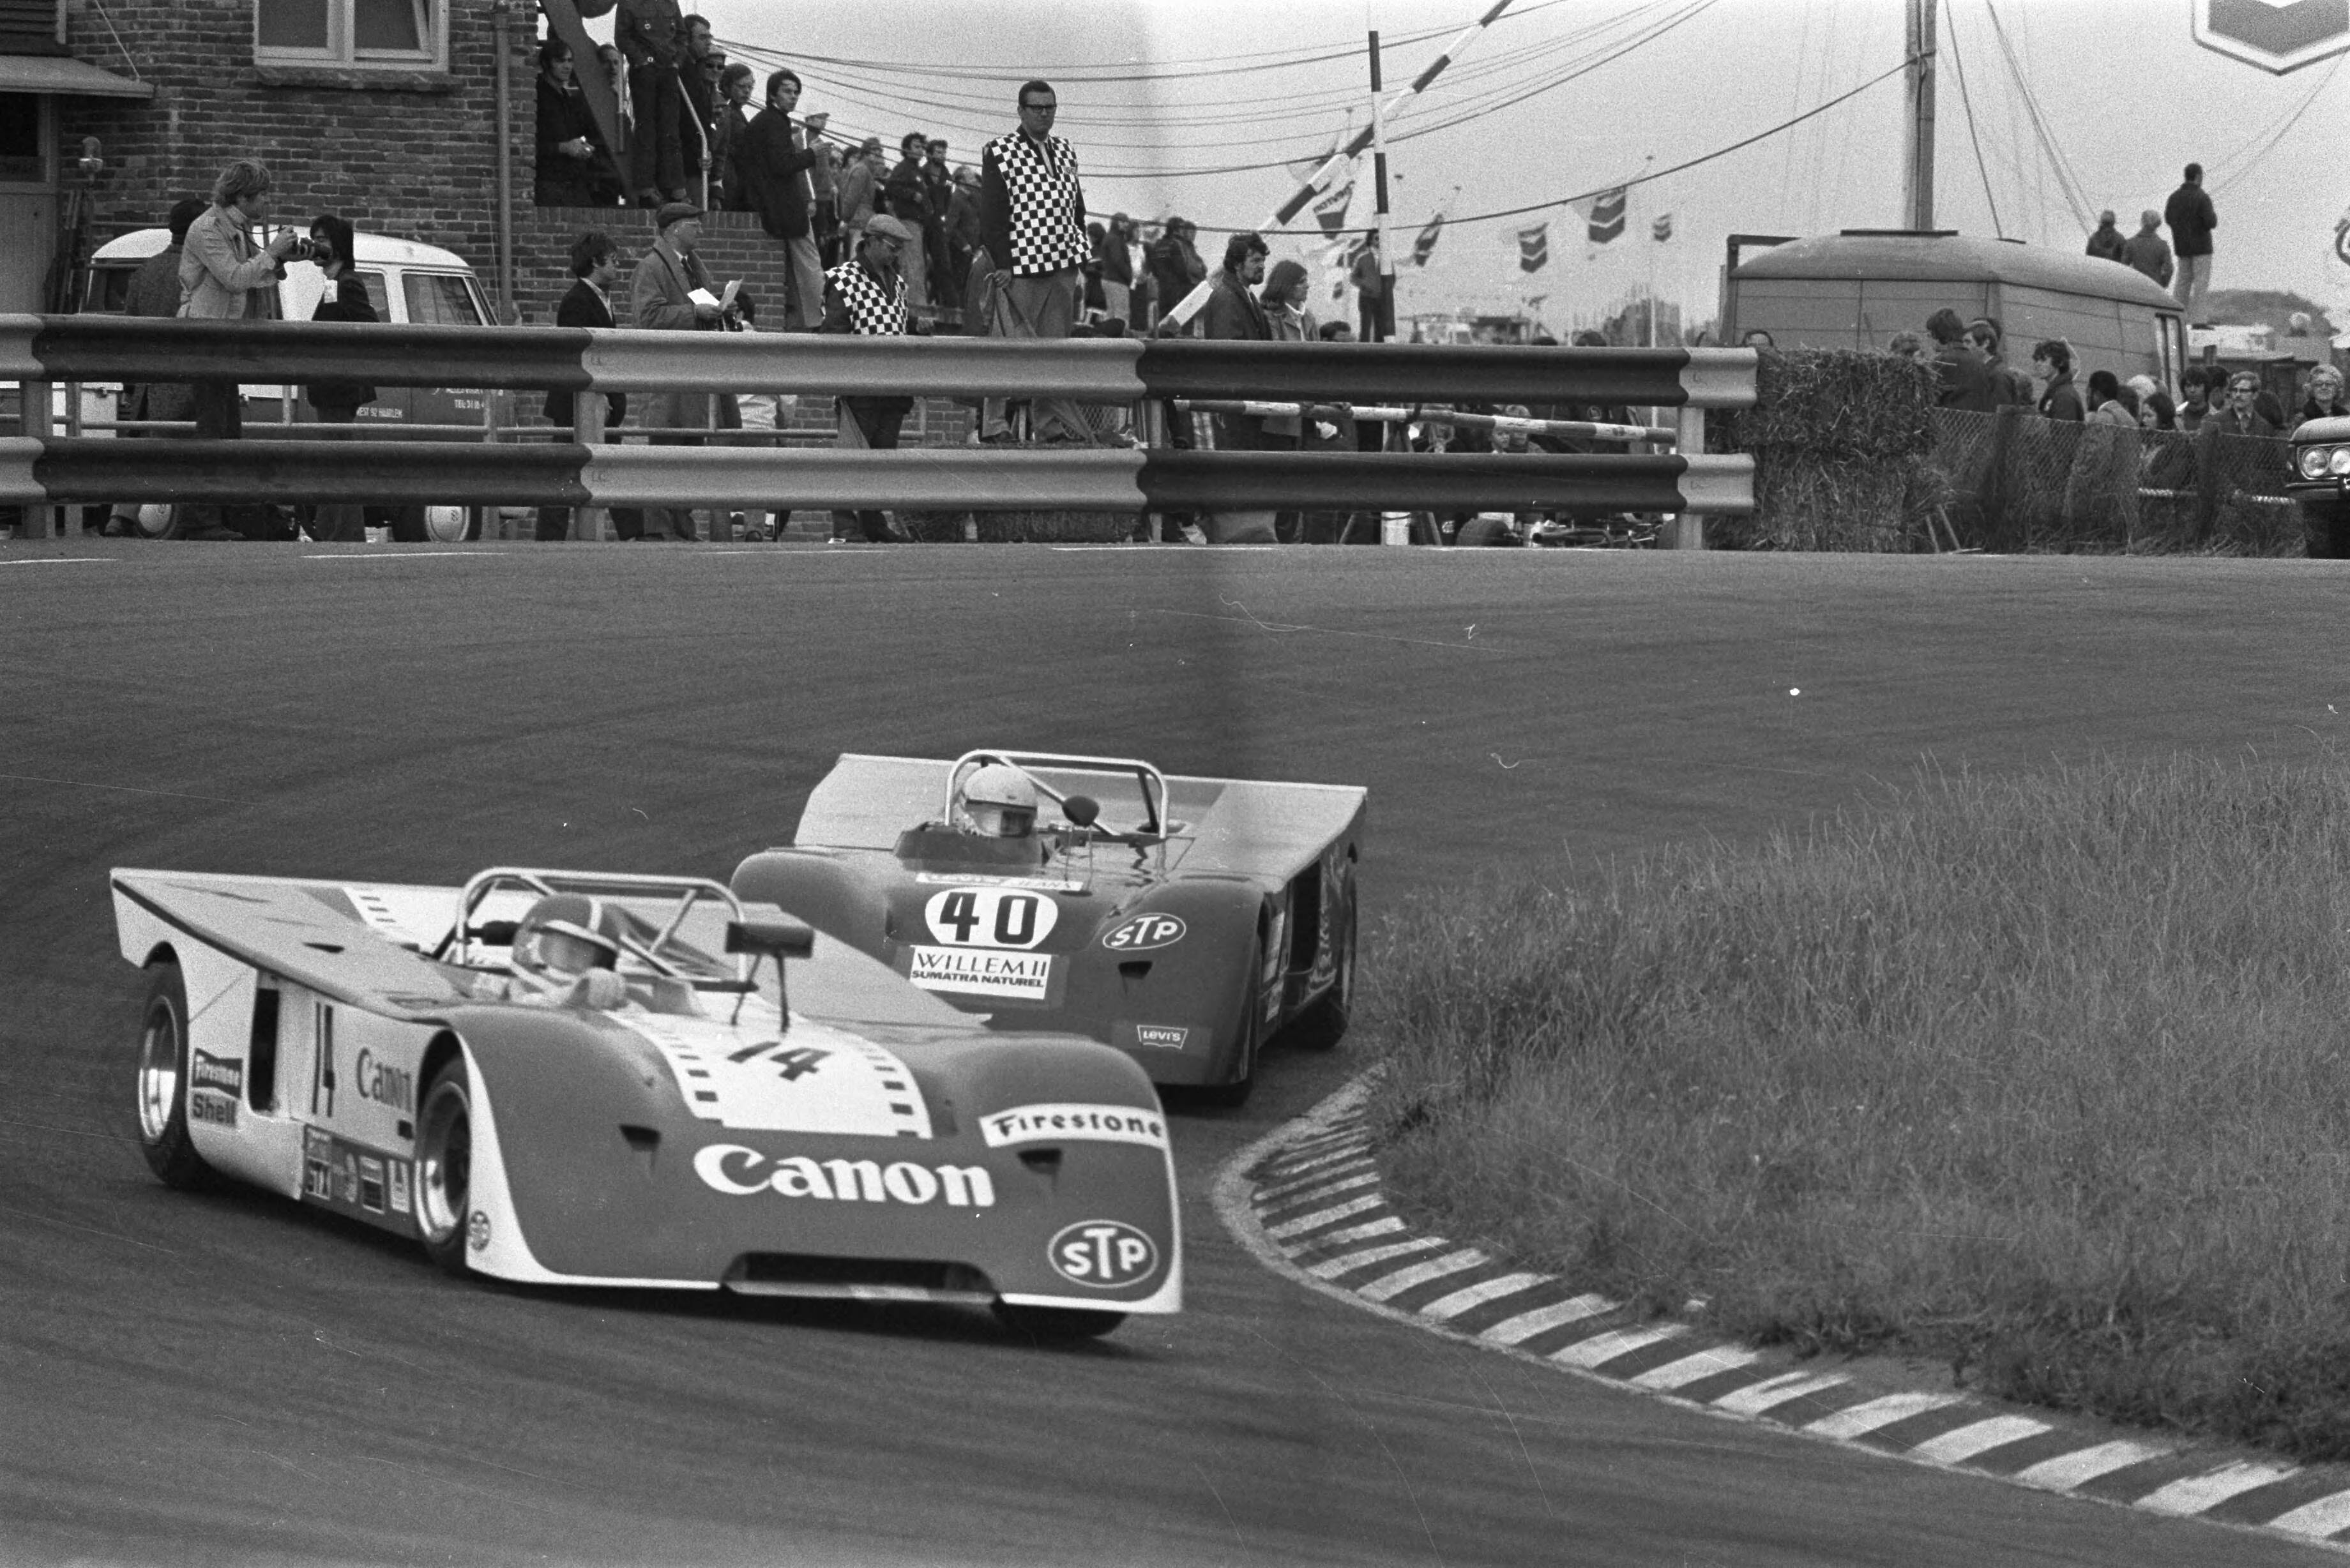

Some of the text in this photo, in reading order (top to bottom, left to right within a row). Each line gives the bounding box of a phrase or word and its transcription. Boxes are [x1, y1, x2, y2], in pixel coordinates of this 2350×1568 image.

[939, 892, 1039, 945] 40
[1111, 916, 1178, 947] STP
[911, 970, 1045, 988] SUMATRA NATUREL
[918, 953, 1047, 977] WILLEM II
[356, 1048, 412, 1112] Canon
[727, 1041, 834, 1082] 14
[192, 1093, 236, 1128] Shell
[992, 1113, 1162, 1138] Firestone
[694, 1143, 996, 1207] Canon
[1062, 1227, 1147, 1279] STP
